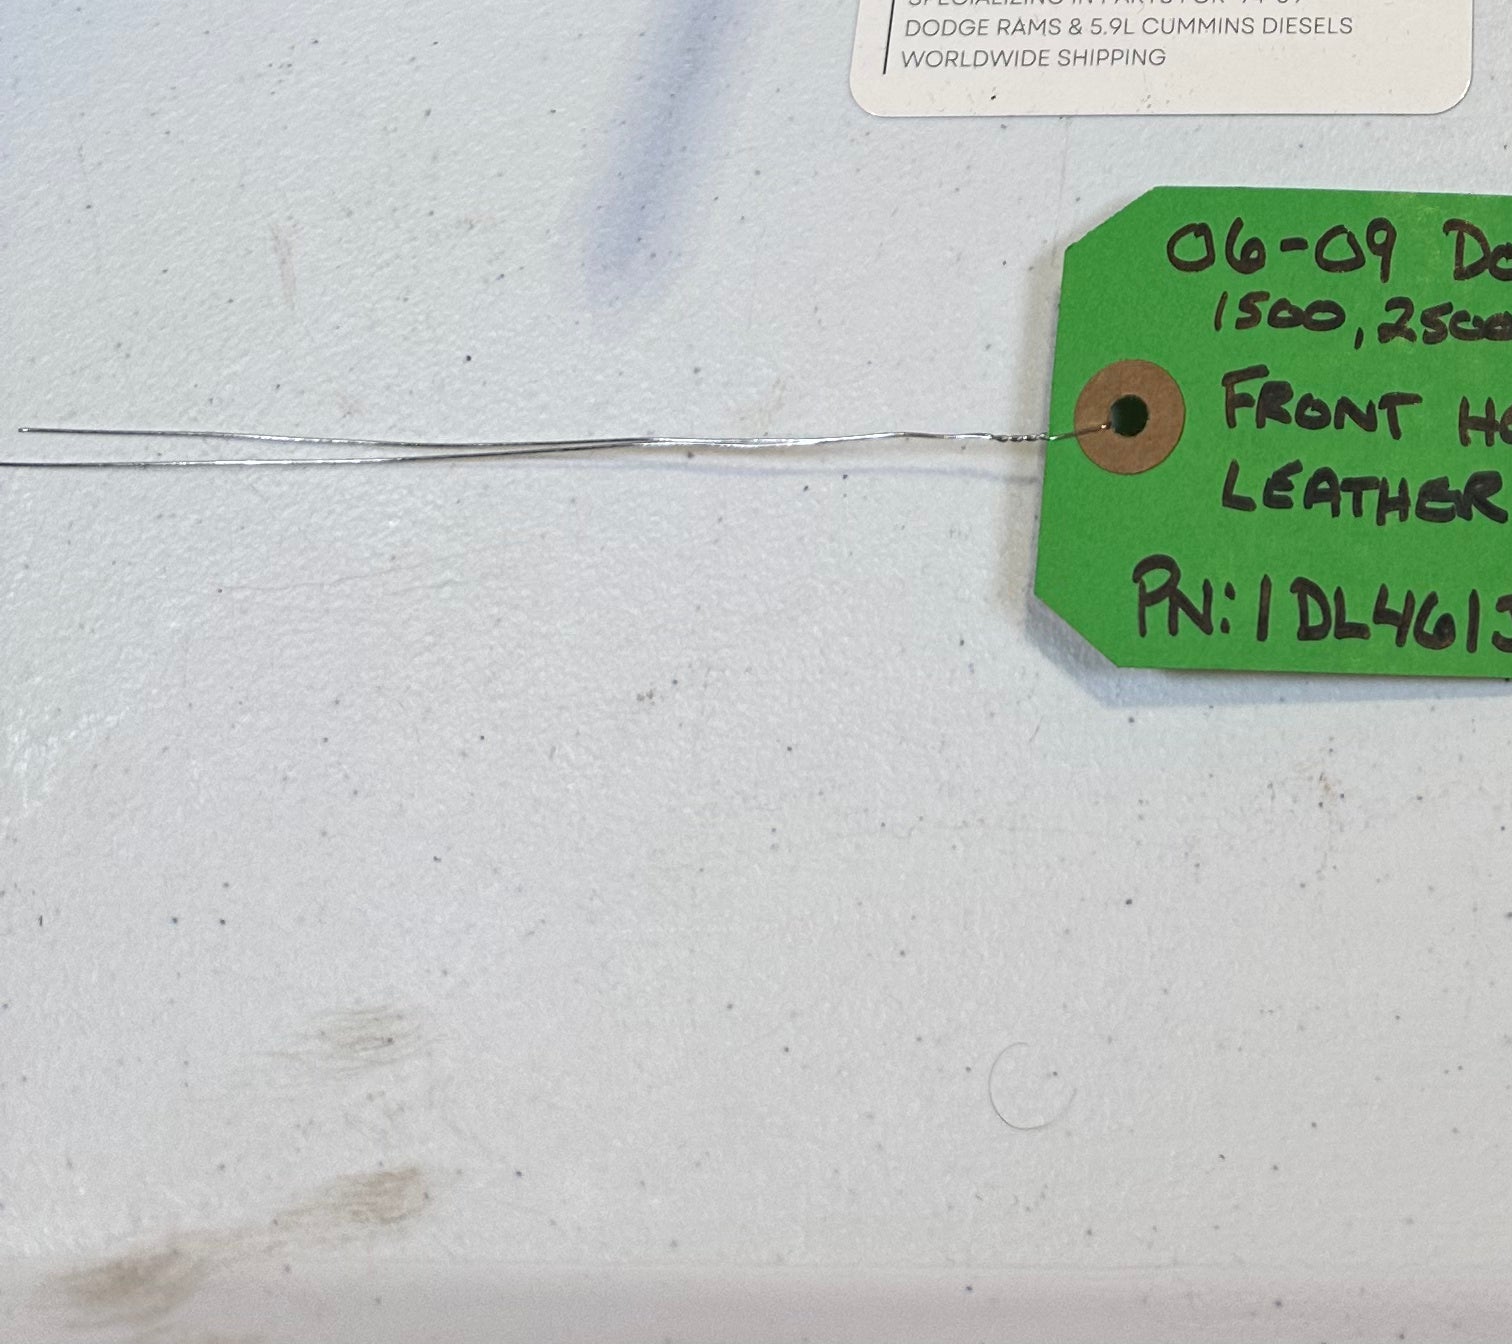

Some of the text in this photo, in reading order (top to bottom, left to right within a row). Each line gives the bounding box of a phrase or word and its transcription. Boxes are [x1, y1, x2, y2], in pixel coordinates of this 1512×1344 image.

[902, 49, 1166, 68] WORLDWIDE SHIPPING
[905, 17, 1352, 36] DODGE RAMS & 5.9L CUMMINS DIESELS
[1167, 217, 1397, 283] 06-09
[1221, 364, 1423, 440] FRONT
[1222, 459, 1508, 526] LEATHER
